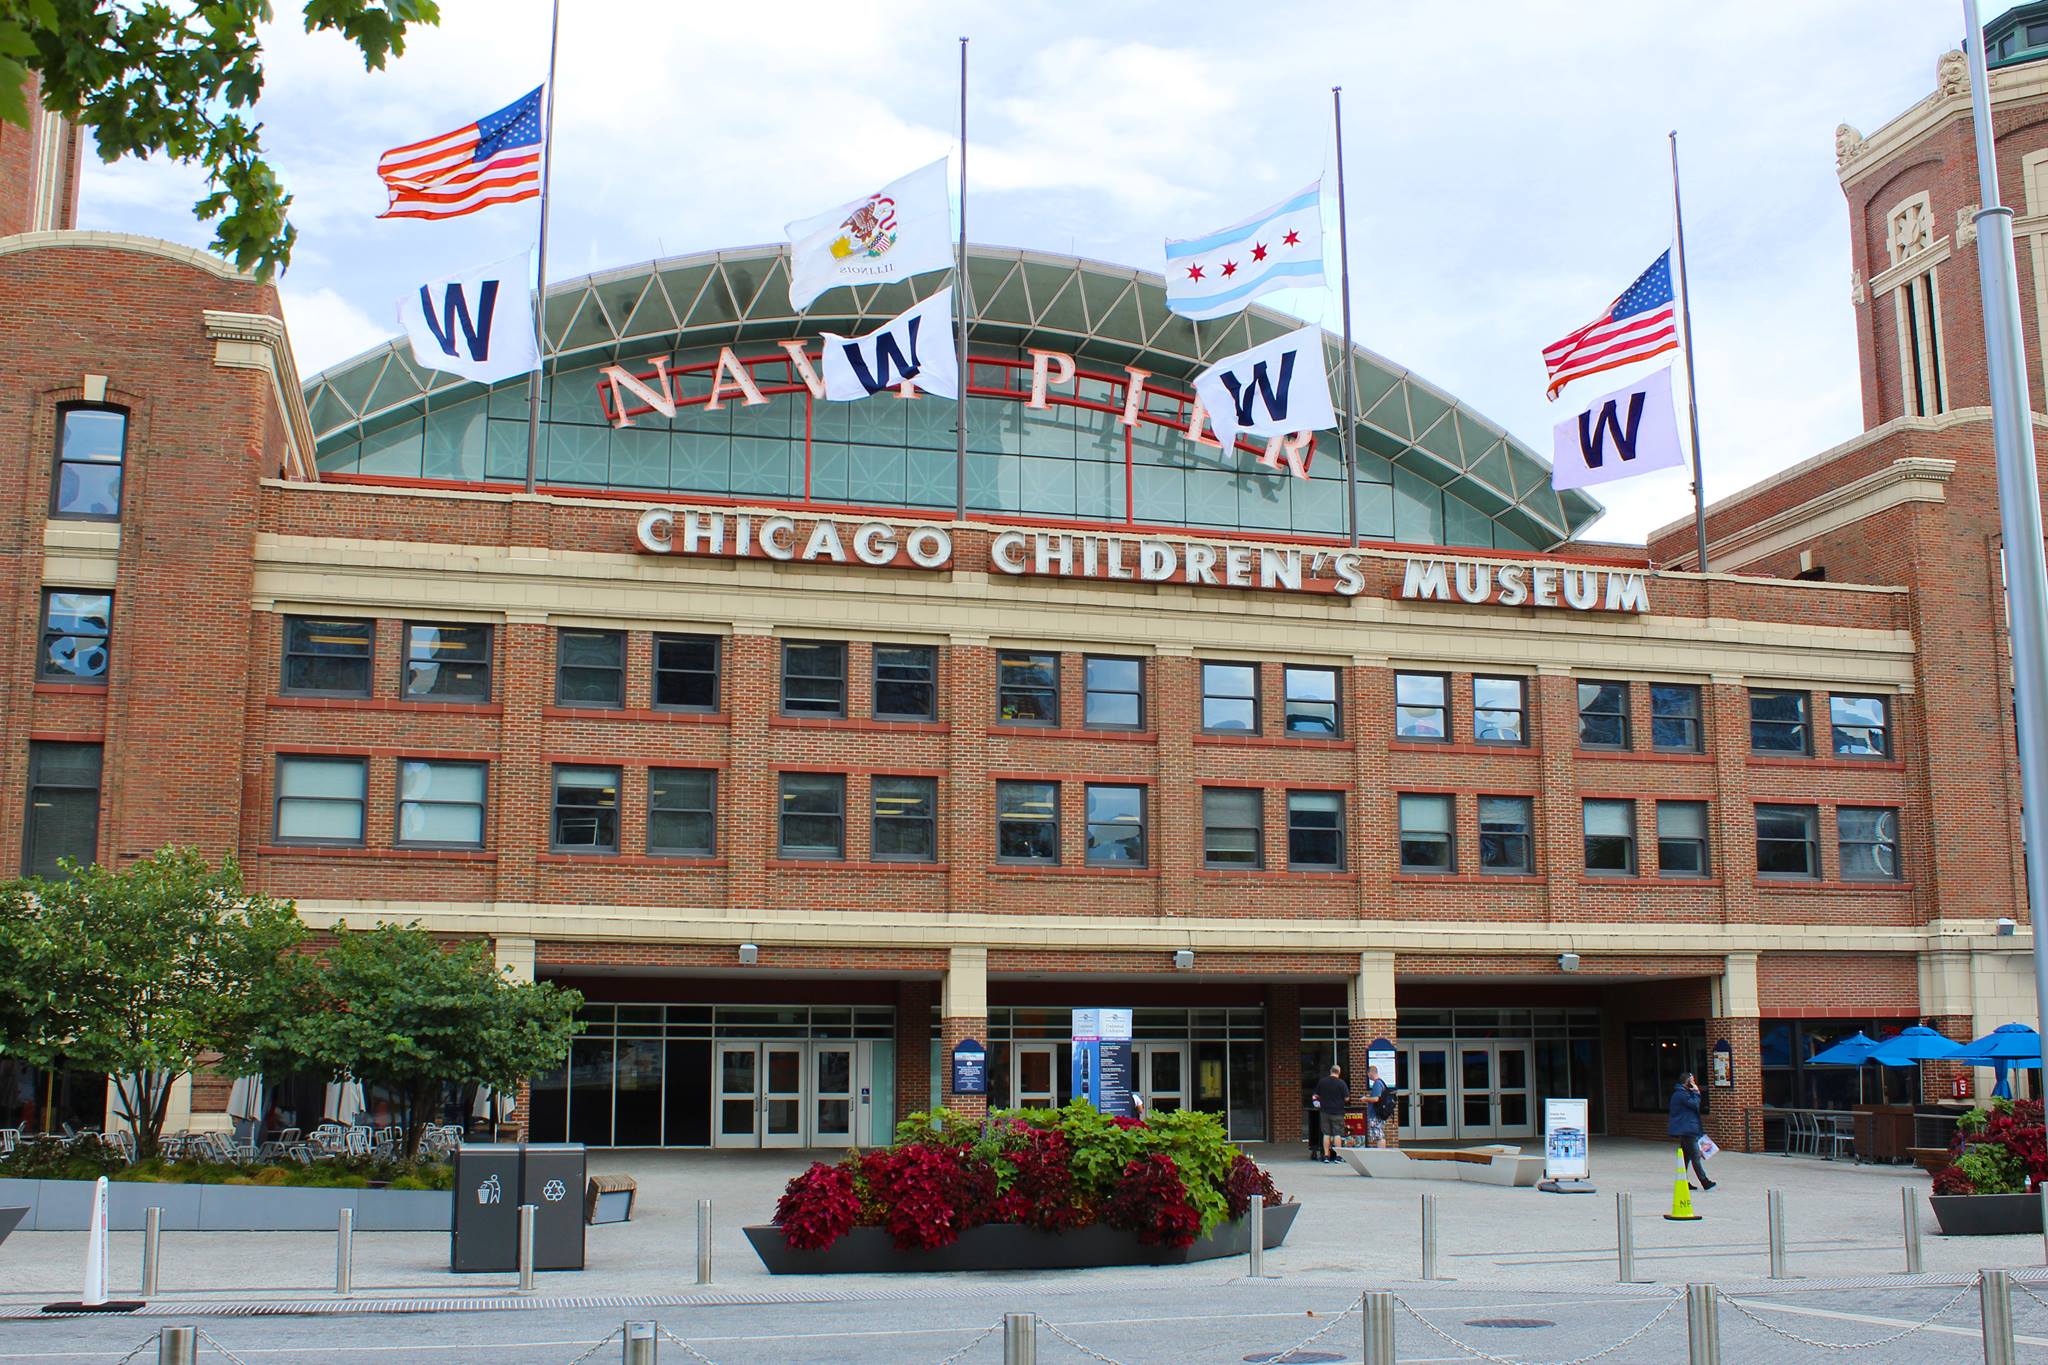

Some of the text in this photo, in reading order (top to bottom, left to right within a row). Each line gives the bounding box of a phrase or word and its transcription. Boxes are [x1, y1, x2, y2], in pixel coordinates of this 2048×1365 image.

[420, 280, 500, 362] W
[842, 315, 922, 396] W
[600, 340, 922, 429] NAV
[1219, 349, 1297, 427] W
[1578, 391, 1647, 470] W
[637, 507, 1650, 613] CHICAGO CHILDREN'S MUSEUM
